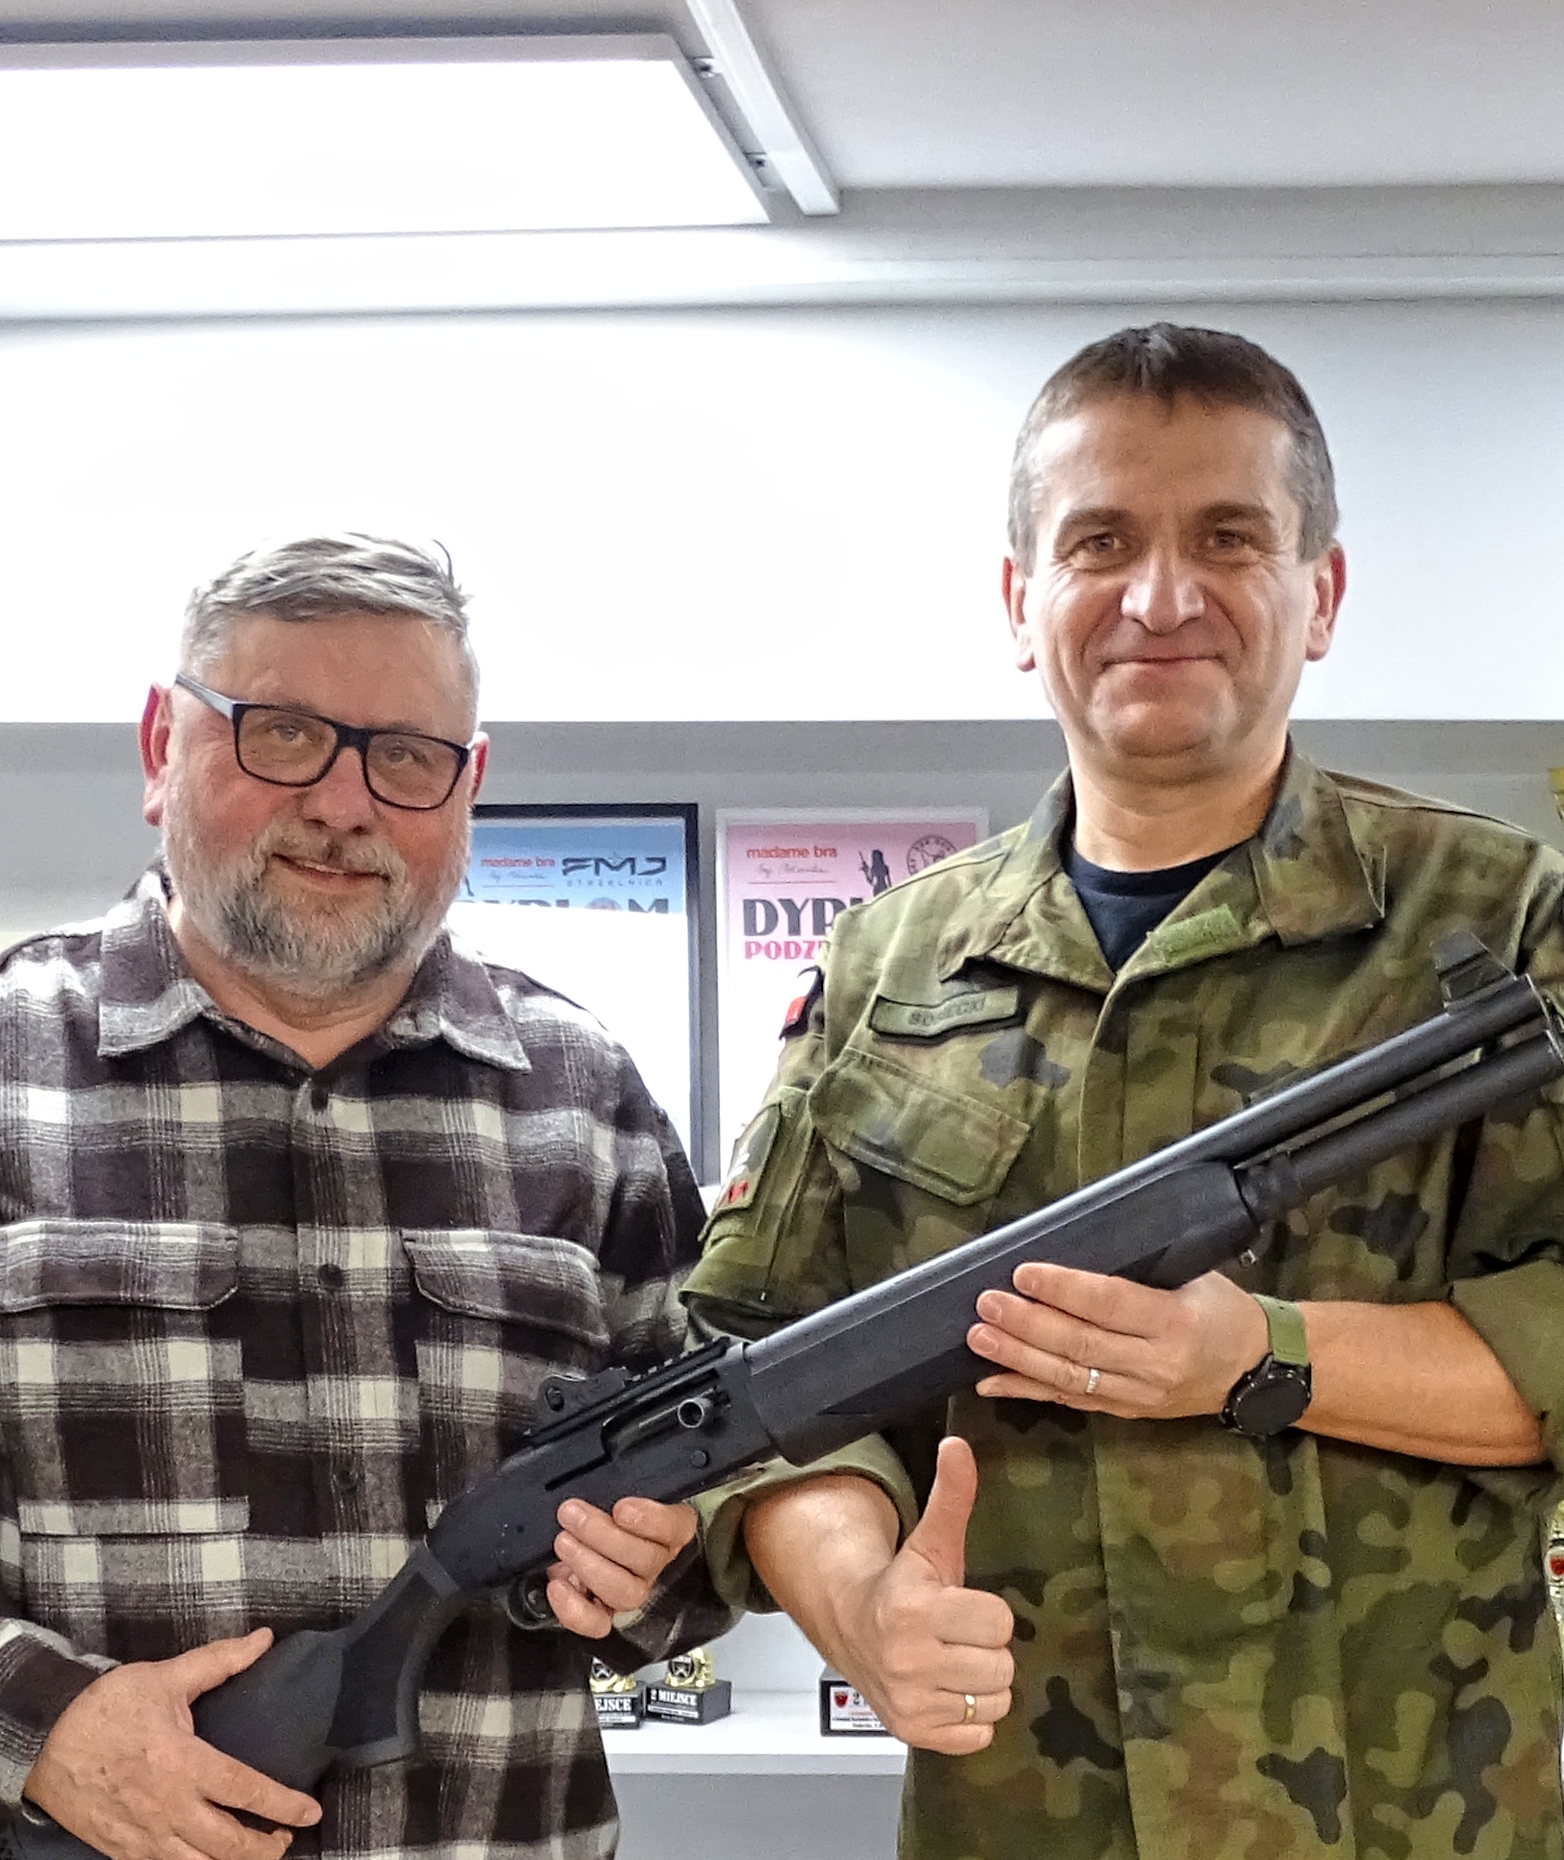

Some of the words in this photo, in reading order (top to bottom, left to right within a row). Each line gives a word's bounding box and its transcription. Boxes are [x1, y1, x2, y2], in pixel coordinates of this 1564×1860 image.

[747, 847, 810, 858] madame
[813, 846, 837, 858] bra
[481, 857, 532, 867] madame
[562, 857, 666, 876] FMJ
[742, 897, 863, 936] DYP
[595, 1698, 632, 1711] EJSCE
